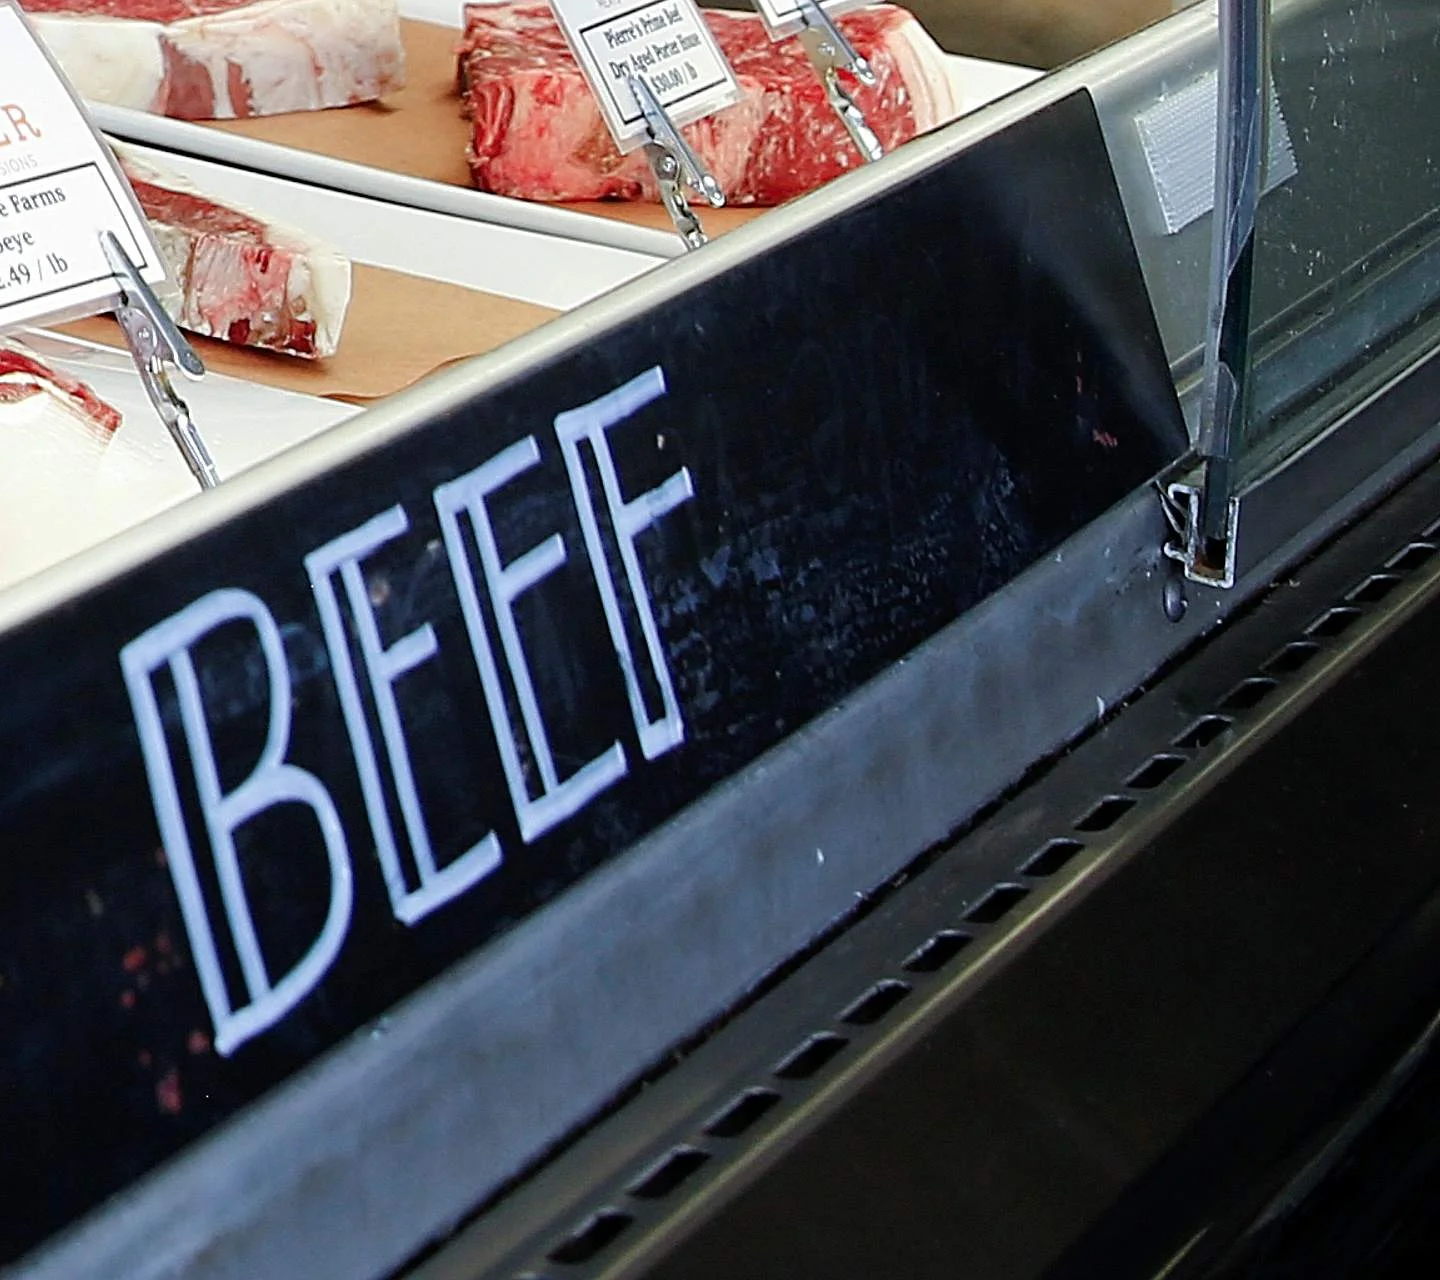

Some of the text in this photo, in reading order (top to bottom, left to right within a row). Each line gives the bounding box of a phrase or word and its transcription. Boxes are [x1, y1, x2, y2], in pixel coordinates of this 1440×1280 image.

[605, 18, 642, 49] Pierre's
[608, 54, 632, 81] Dry
[629, 48, 656, 73] Aged
[11, 185, 67, 215] Farms
[46, 253, 69, 275] lb
[118, 364, 696, 1058] BEEF
